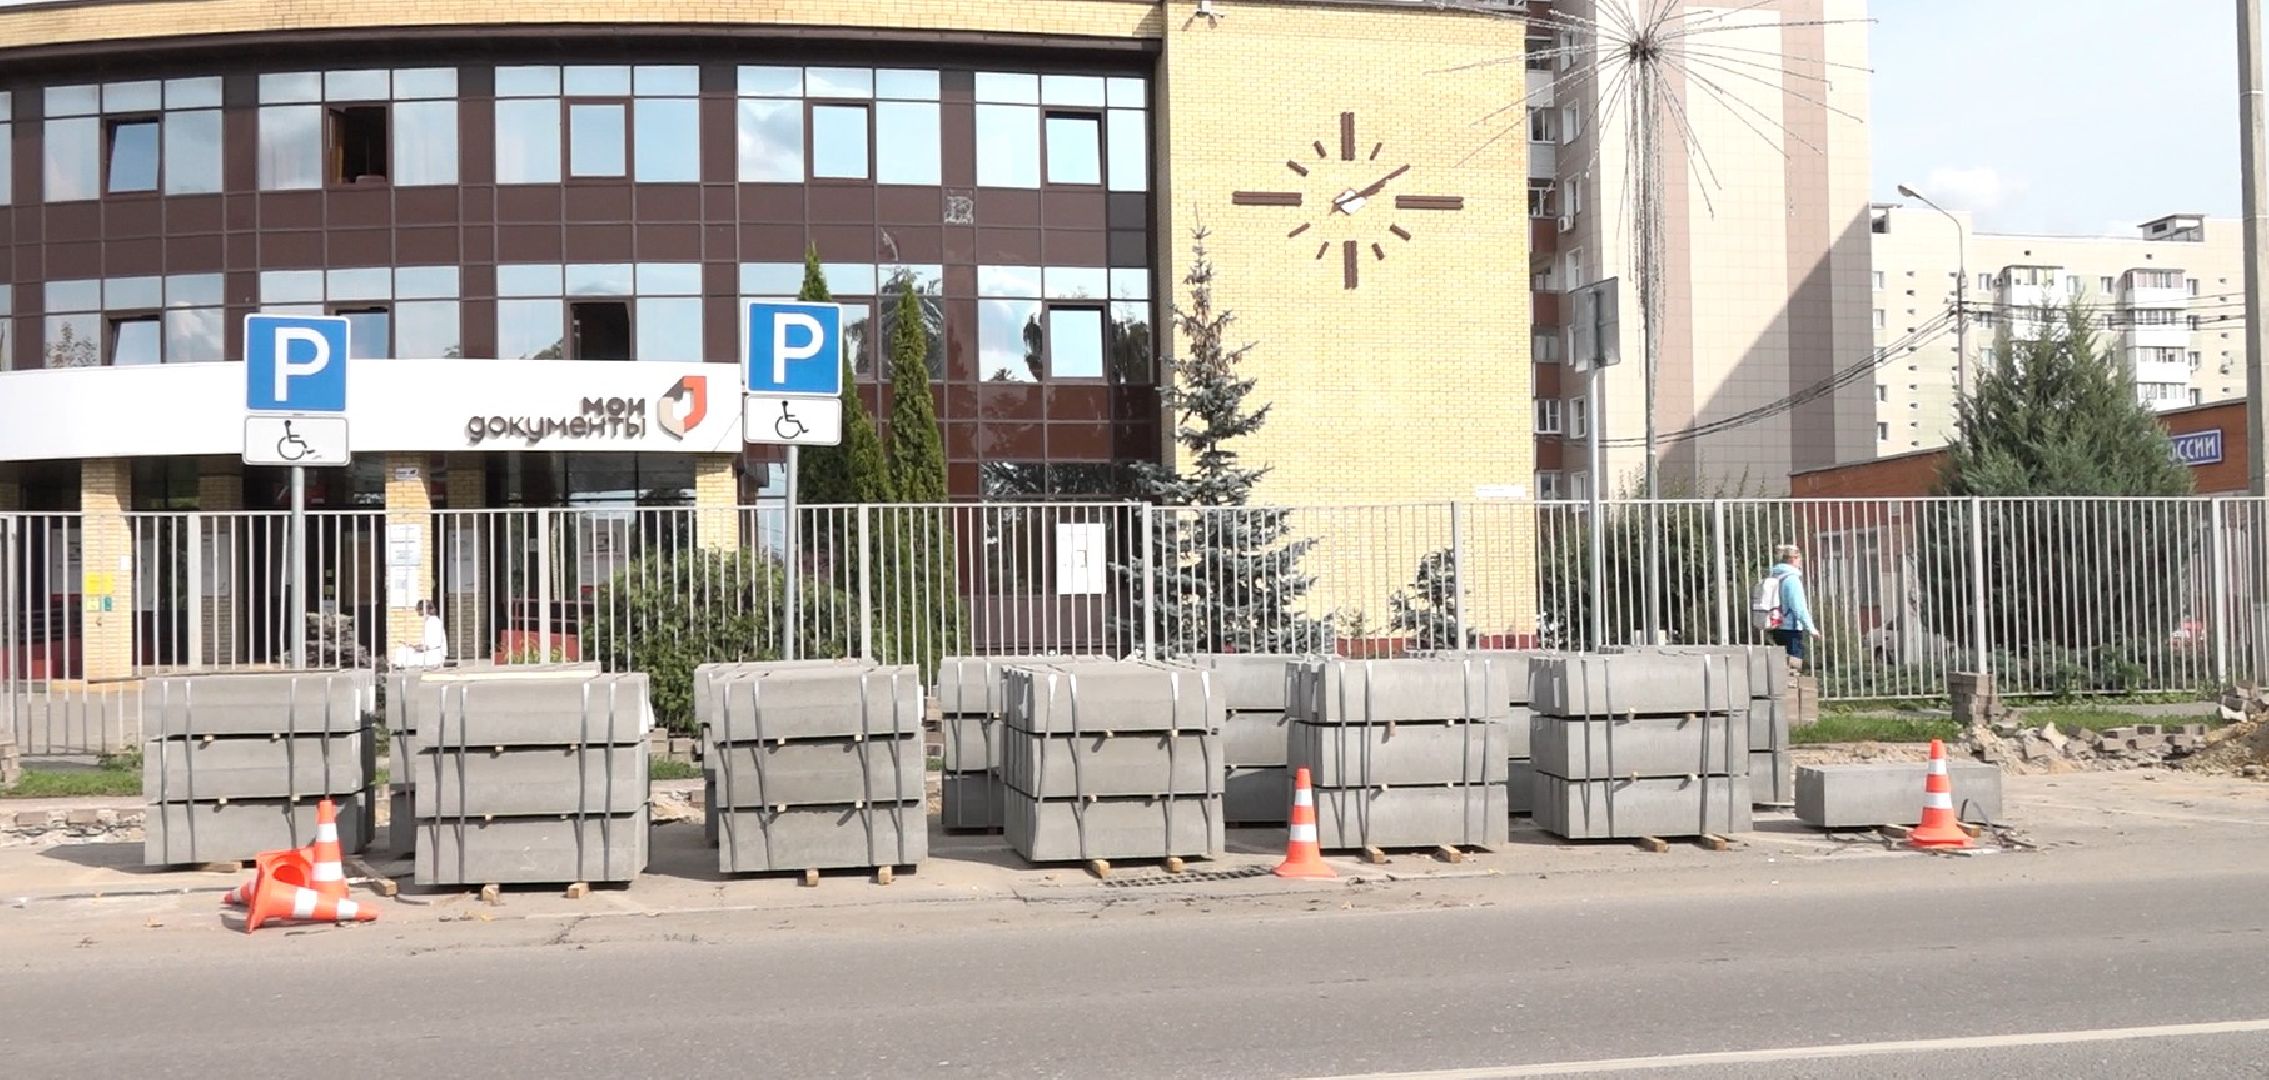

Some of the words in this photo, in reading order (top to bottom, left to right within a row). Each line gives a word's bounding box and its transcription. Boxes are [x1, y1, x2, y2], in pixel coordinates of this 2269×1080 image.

[275, 327, 330, 401] P
[774, 311, 824, 384] P
[464, 416, 645, 446] документы
